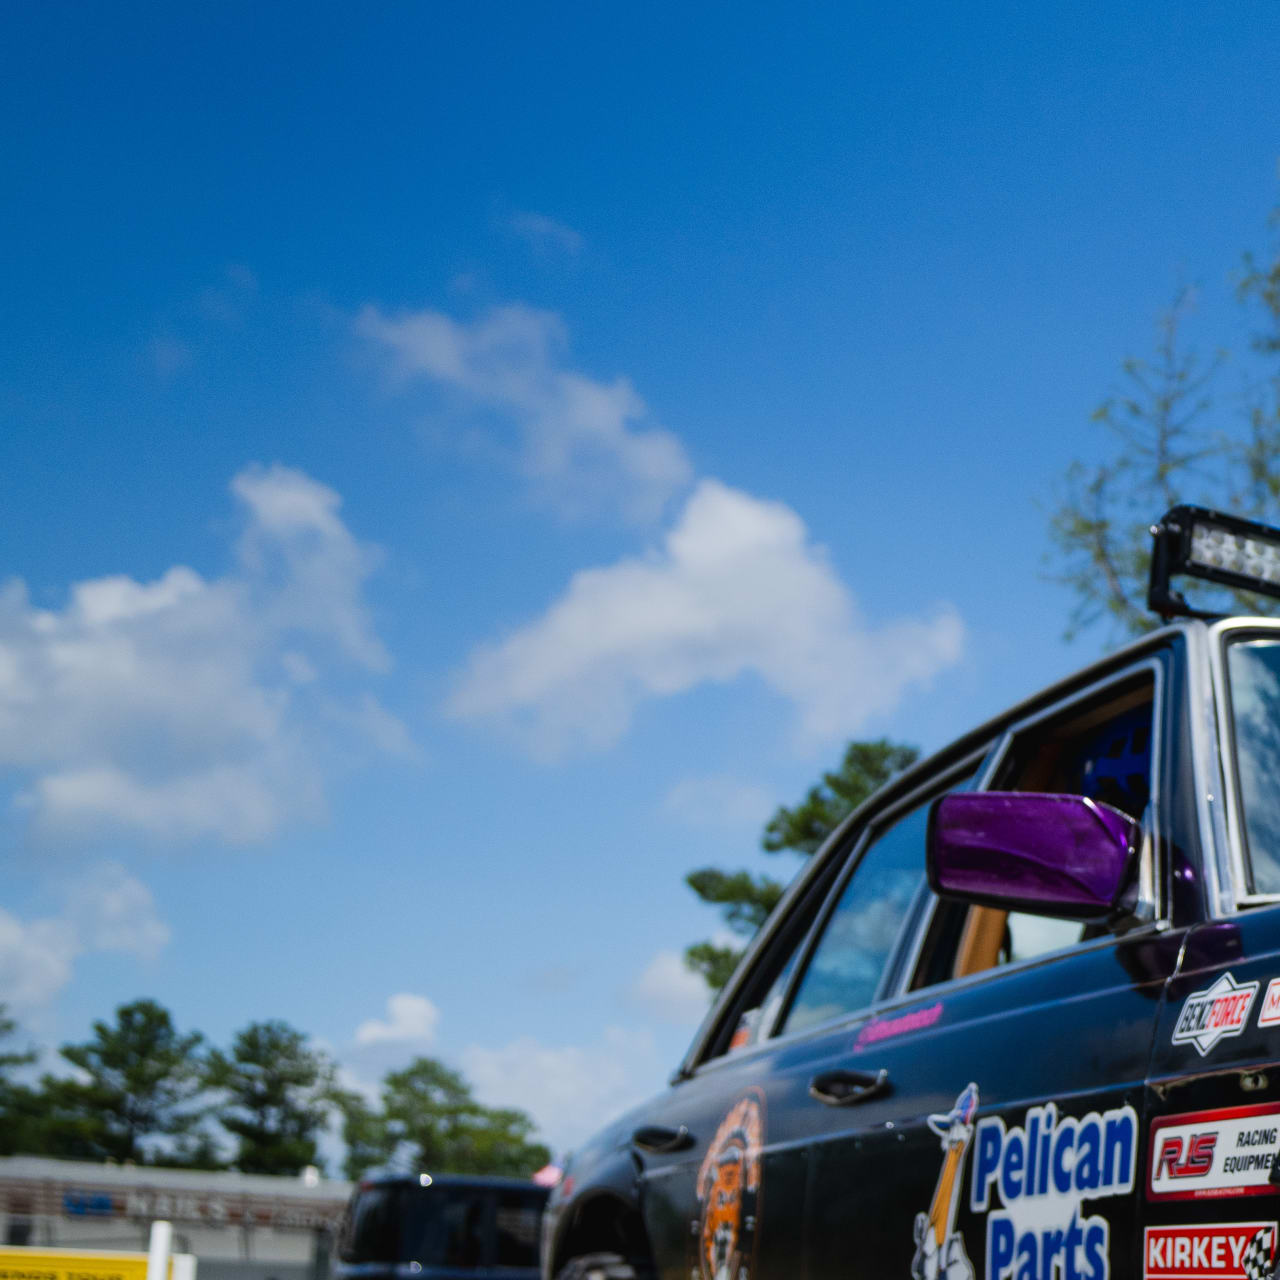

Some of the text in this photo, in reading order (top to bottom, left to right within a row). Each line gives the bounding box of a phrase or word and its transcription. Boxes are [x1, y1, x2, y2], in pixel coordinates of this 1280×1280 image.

[975, 1112, 1134, 1203] Pelican
[1154, 1131, 1219, 1180] RJS
[1236, 1128, 1278, 1148] RACING
[1149, 1236, 1247, 1268] KIRKEY
